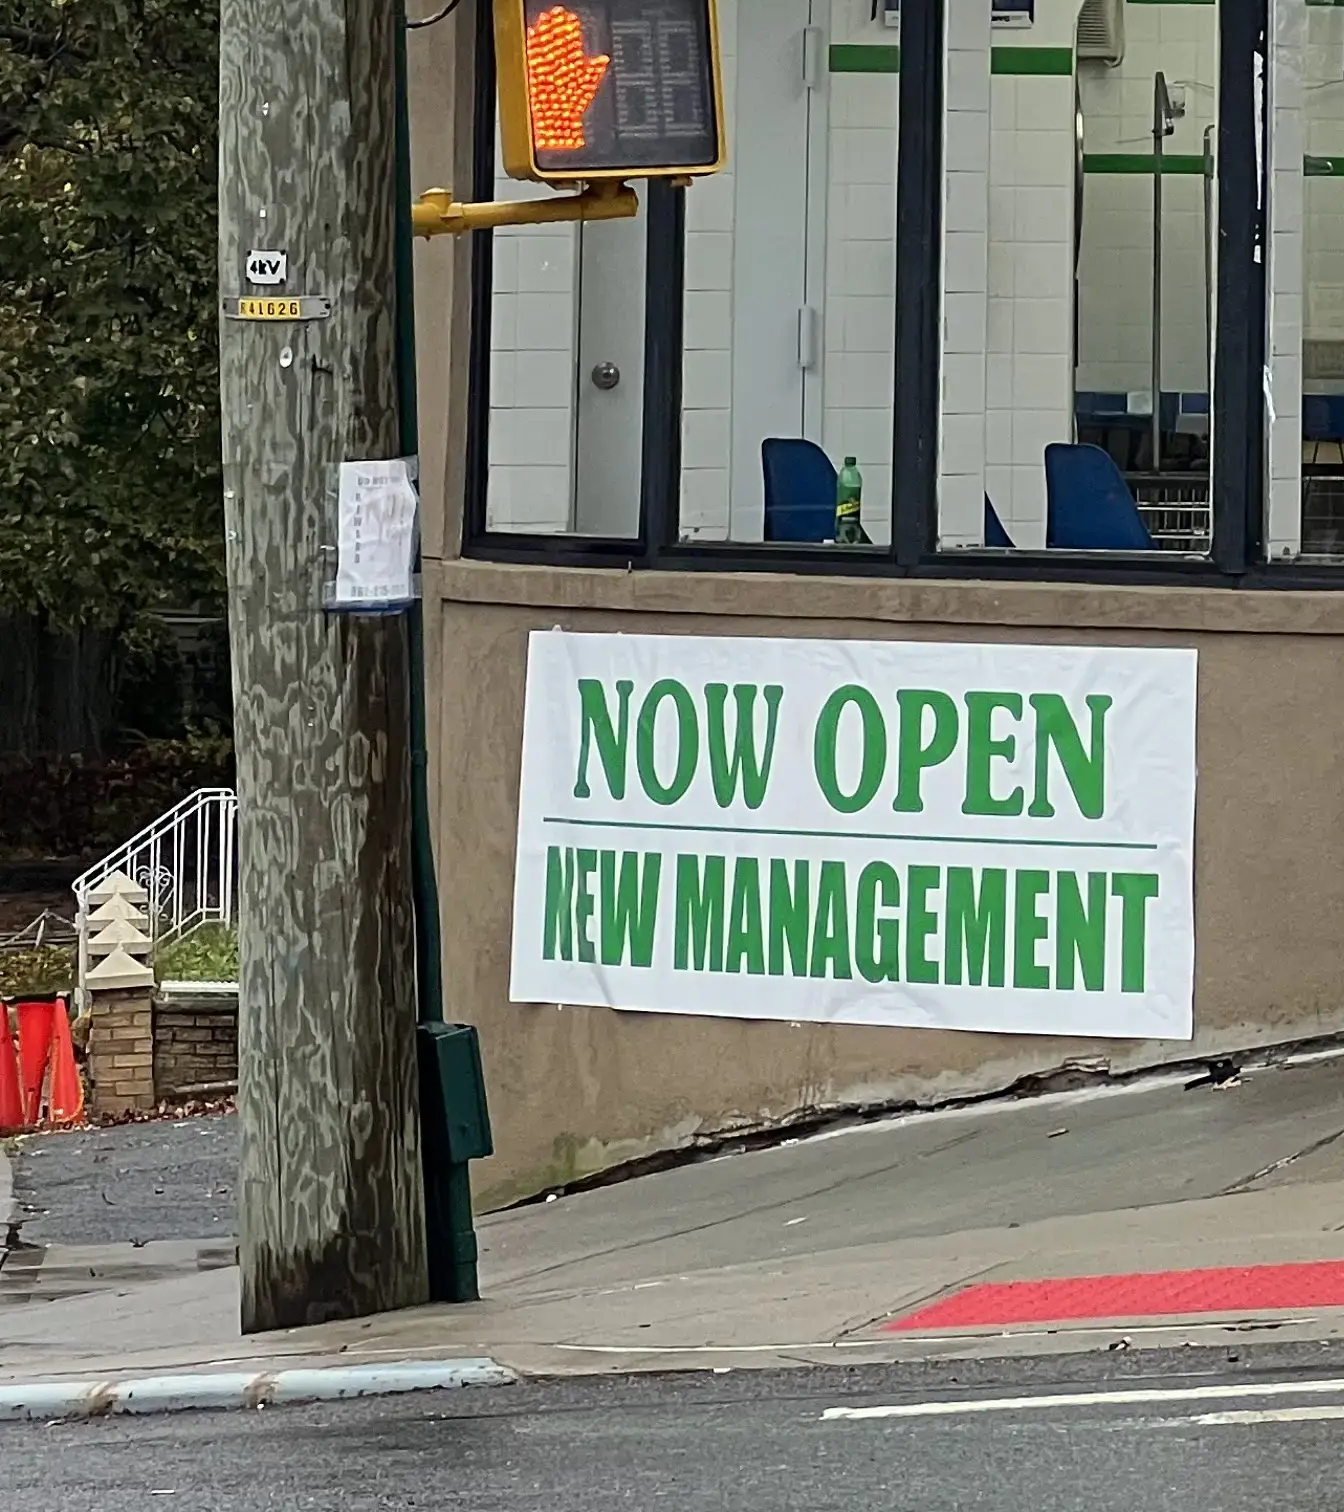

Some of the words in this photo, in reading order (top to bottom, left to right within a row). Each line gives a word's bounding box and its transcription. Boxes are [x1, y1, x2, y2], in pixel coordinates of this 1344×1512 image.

[573, 678, 784, 811] NOW
[813, 684, 1114, 820] OPEN
[542, 845, 663, 968] NEW
[673, 853, 1160, 994] MANAGEMENT
